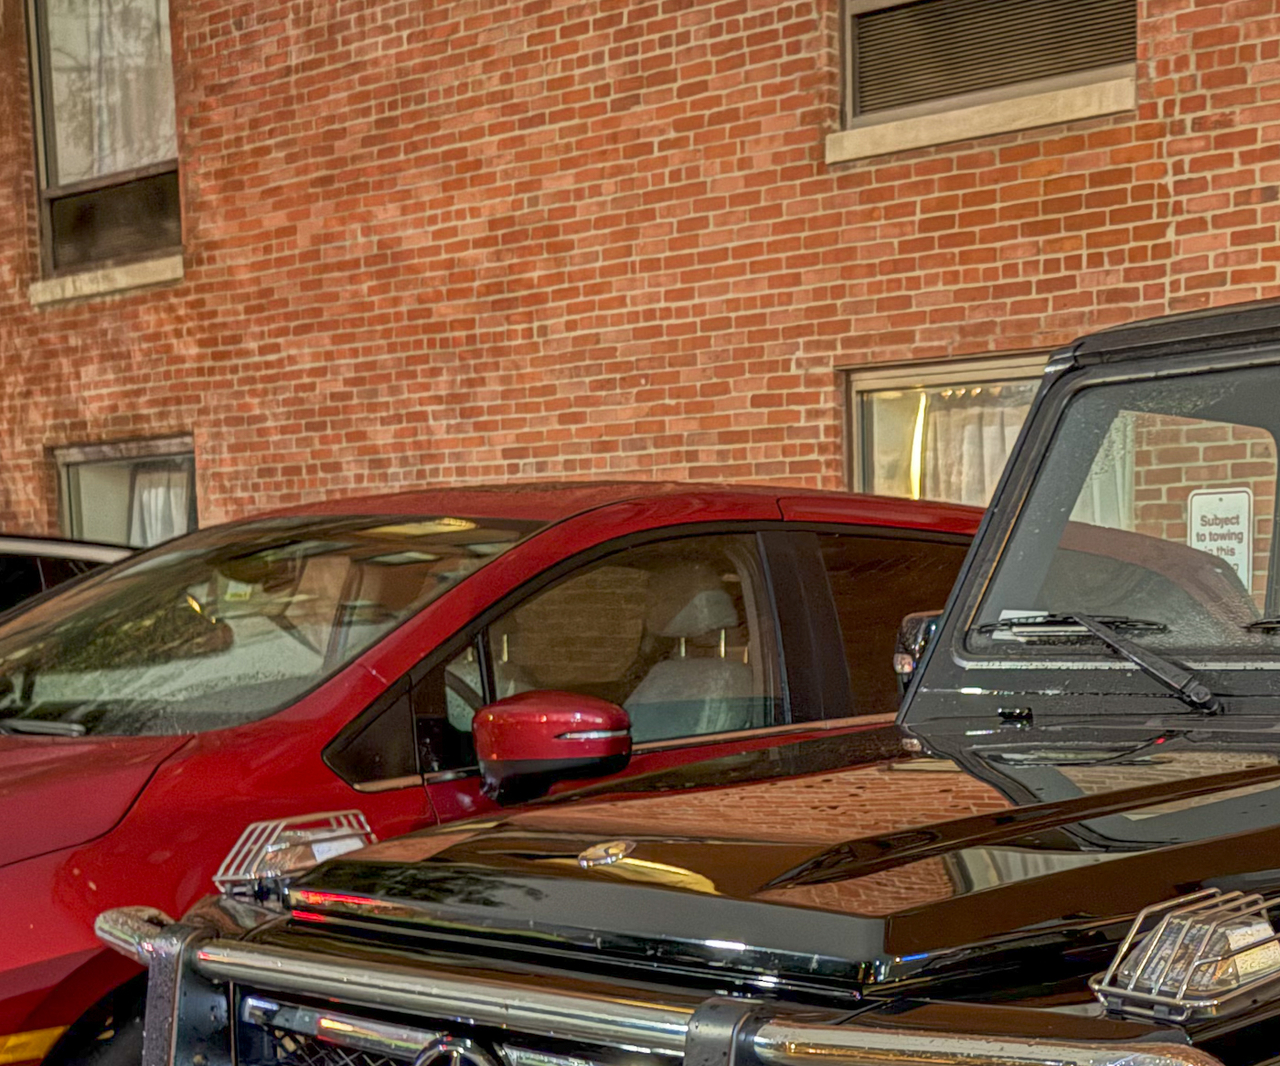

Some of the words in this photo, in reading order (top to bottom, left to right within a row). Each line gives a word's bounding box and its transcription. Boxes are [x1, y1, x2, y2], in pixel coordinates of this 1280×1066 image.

[1200, 514, 1240, 528] Subject
[1196, 531, 1206, 543] to
[1209, 530, 1244, 543] towing
[1216, 545, 1236, 557] this
